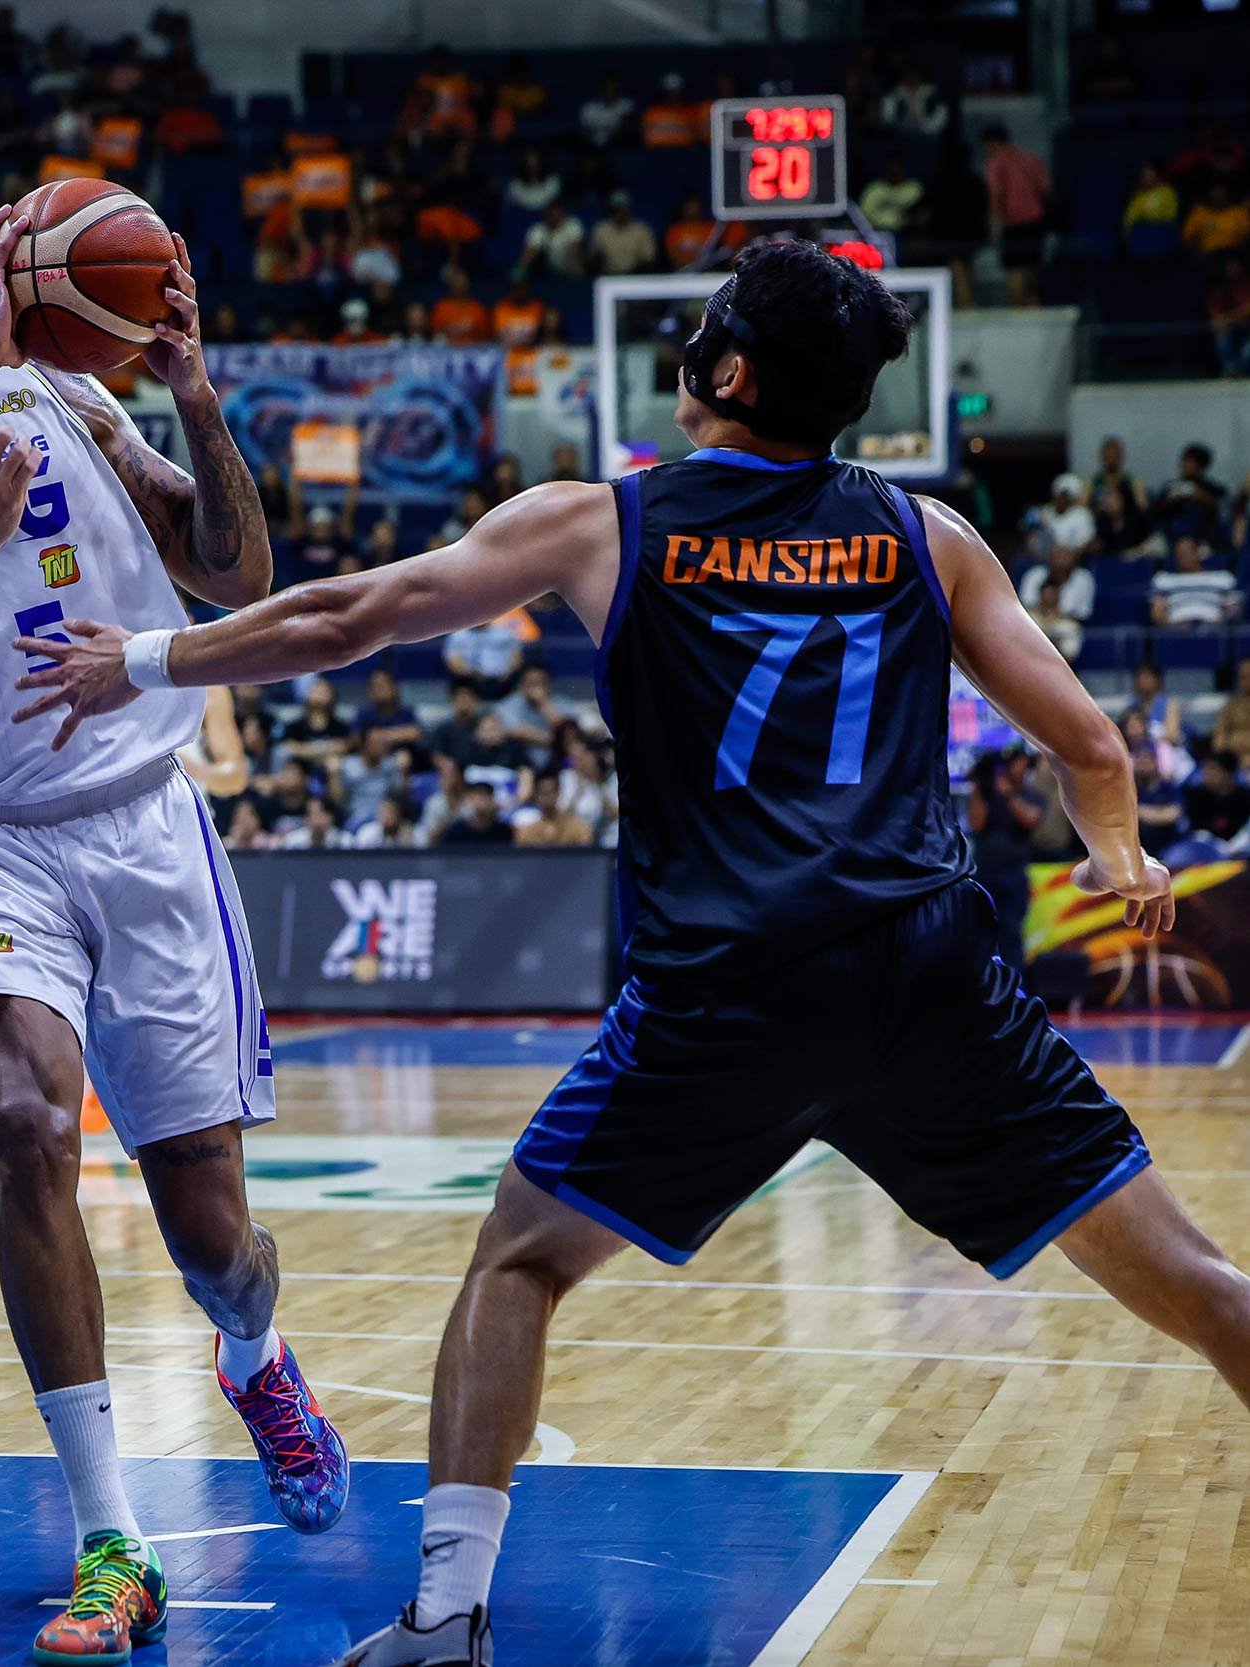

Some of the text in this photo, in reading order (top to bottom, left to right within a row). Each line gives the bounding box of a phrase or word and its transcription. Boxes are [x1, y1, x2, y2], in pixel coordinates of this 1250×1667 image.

[748, 146, 812, 200] 20
[37, 268, 67, 283] PBA 2
[39, 545, 78, 588] TNT
[662, 534, 899, 584] CANSINO
[711, 612, 887, 791] 71
[330, 878, 437, 920] WE
